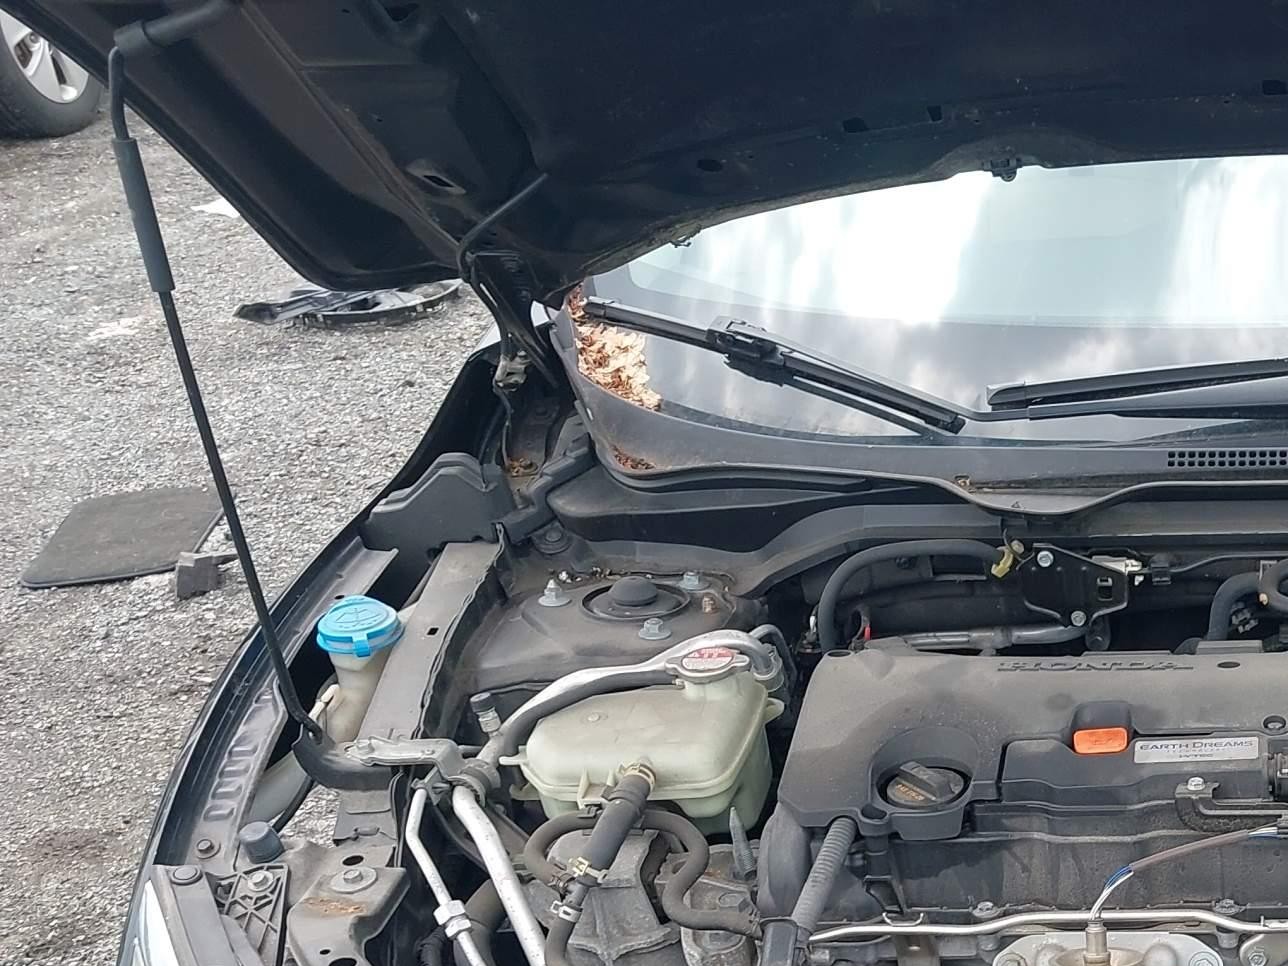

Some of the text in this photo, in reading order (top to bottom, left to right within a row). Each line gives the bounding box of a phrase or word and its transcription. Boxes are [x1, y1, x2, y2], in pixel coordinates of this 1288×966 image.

[996, 661, 1195, 673] HONDA
[1139, 740, 1254, 751] EARTH DREAMS
